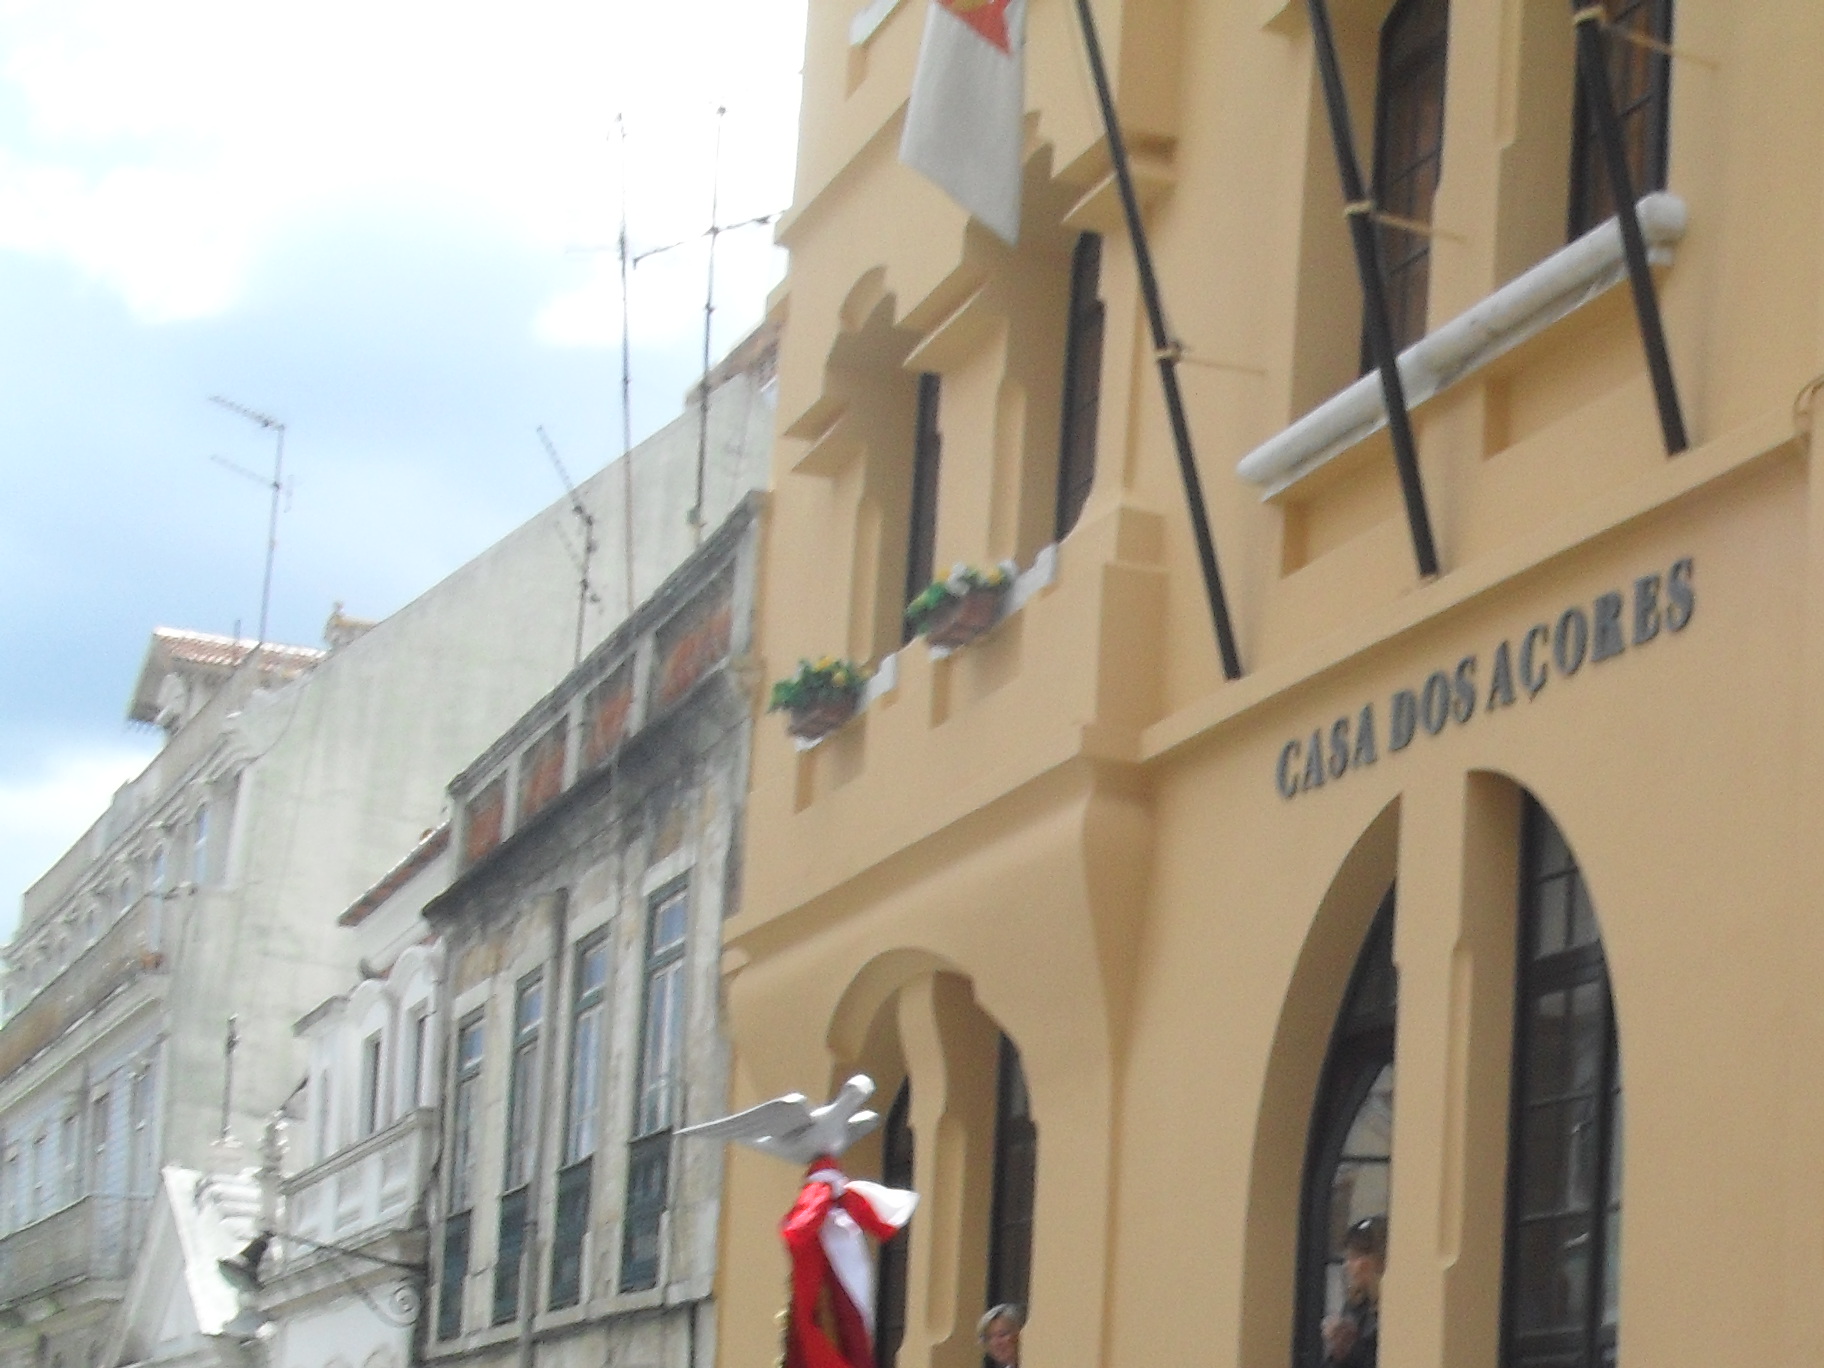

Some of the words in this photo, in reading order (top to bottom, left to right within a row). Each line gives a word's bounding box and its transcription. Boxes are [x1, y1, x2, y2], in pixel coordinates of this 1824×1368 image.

[1276, 703, 1378, 800] CASA
[1388, 655, 1478, 752] DOS
[1486, 556, 1696, 712] AÇORES
